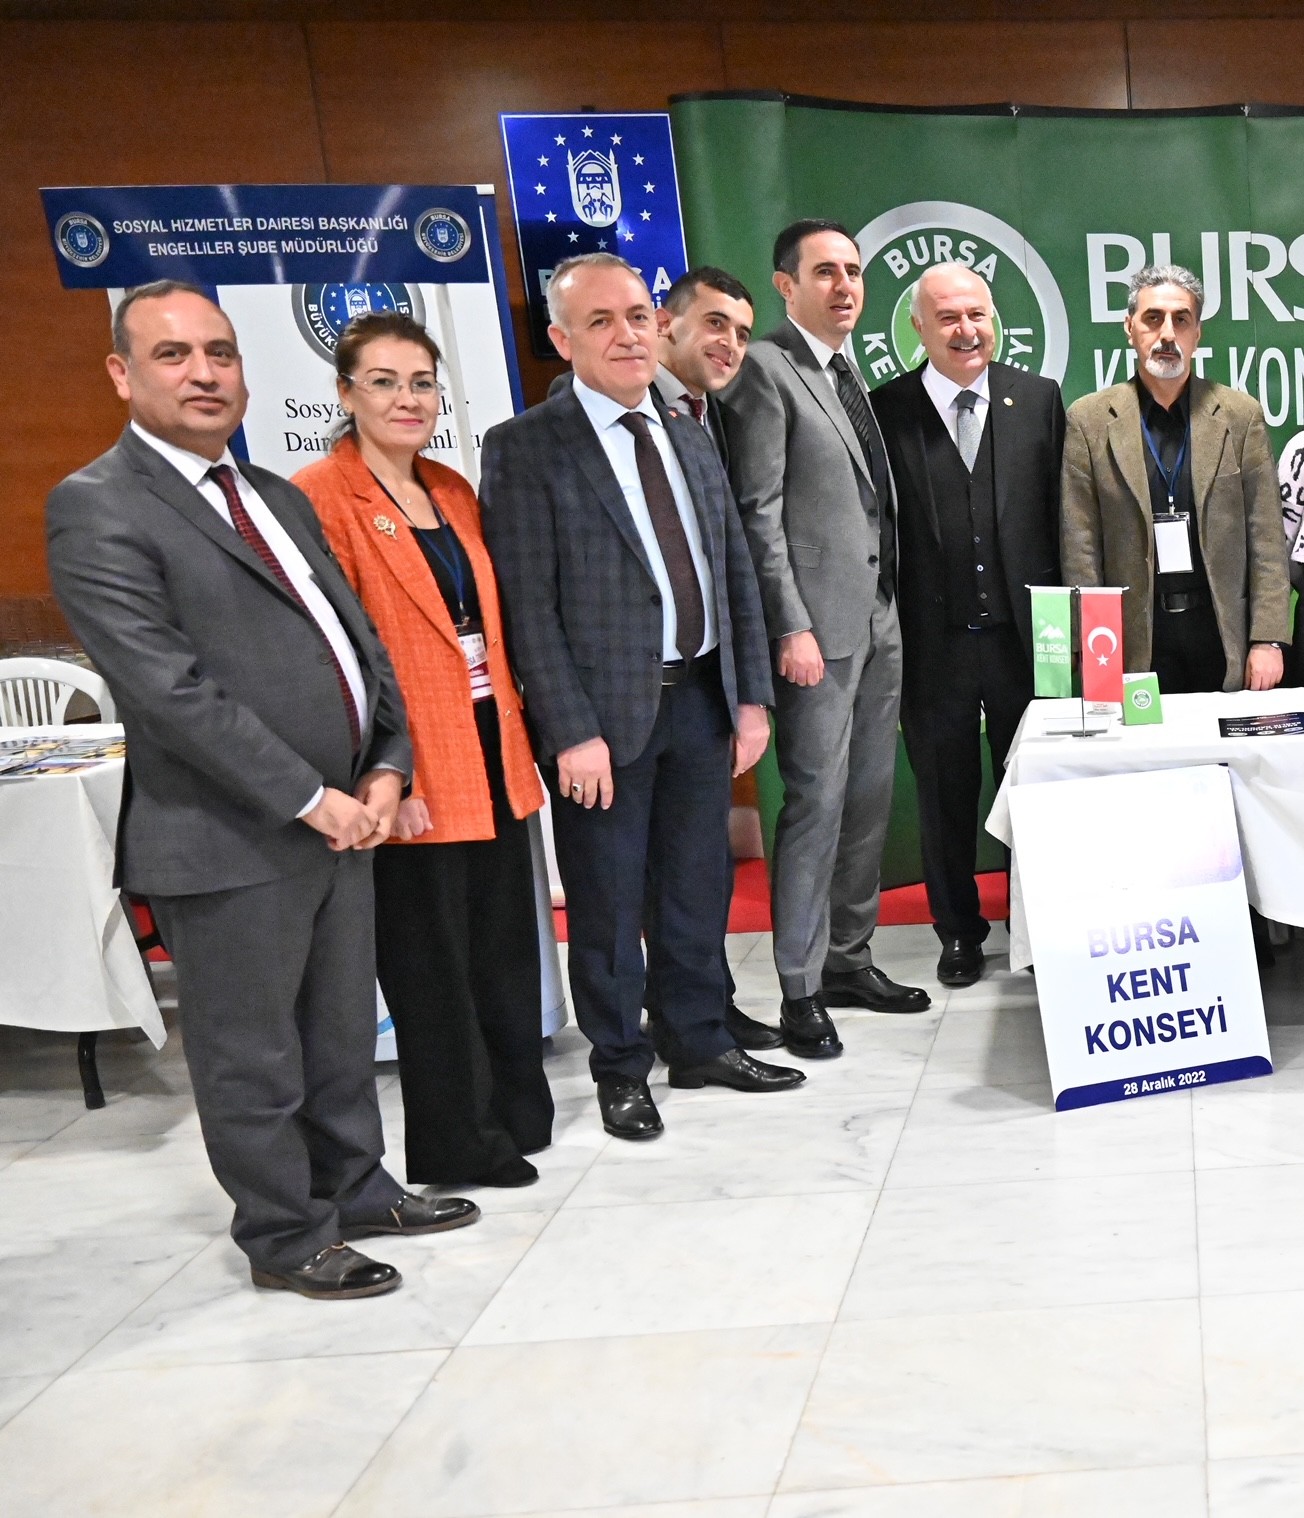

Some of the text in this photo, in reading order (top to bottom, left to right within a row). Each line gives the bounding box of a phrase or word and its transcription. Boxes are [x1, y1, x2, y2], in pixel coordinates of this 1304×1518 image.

[113, 220, 168, 234] SOSYAL
[318, 215, 408, 232] BAŞKANLIĞI
[238, 240, 279, 256] ŞUBE
[281, 237, 379, 254] MÜDÜRLÜĞÜ
[882, 234, 998, 283] BURSA
[308, 303, 338, 352] BÜYÜK
[285, 398, 346, 423] Sosya
[1035, 642, 1069, 655] BURSA
[1087, 915, 1200, 958] BURSA
[1107, 962, 1191, 1003] KENT
[1084, 996, 1228, 1055] KONSEYİ
[1123, 1070, 1206, 1095] 28 Aralık 2022
